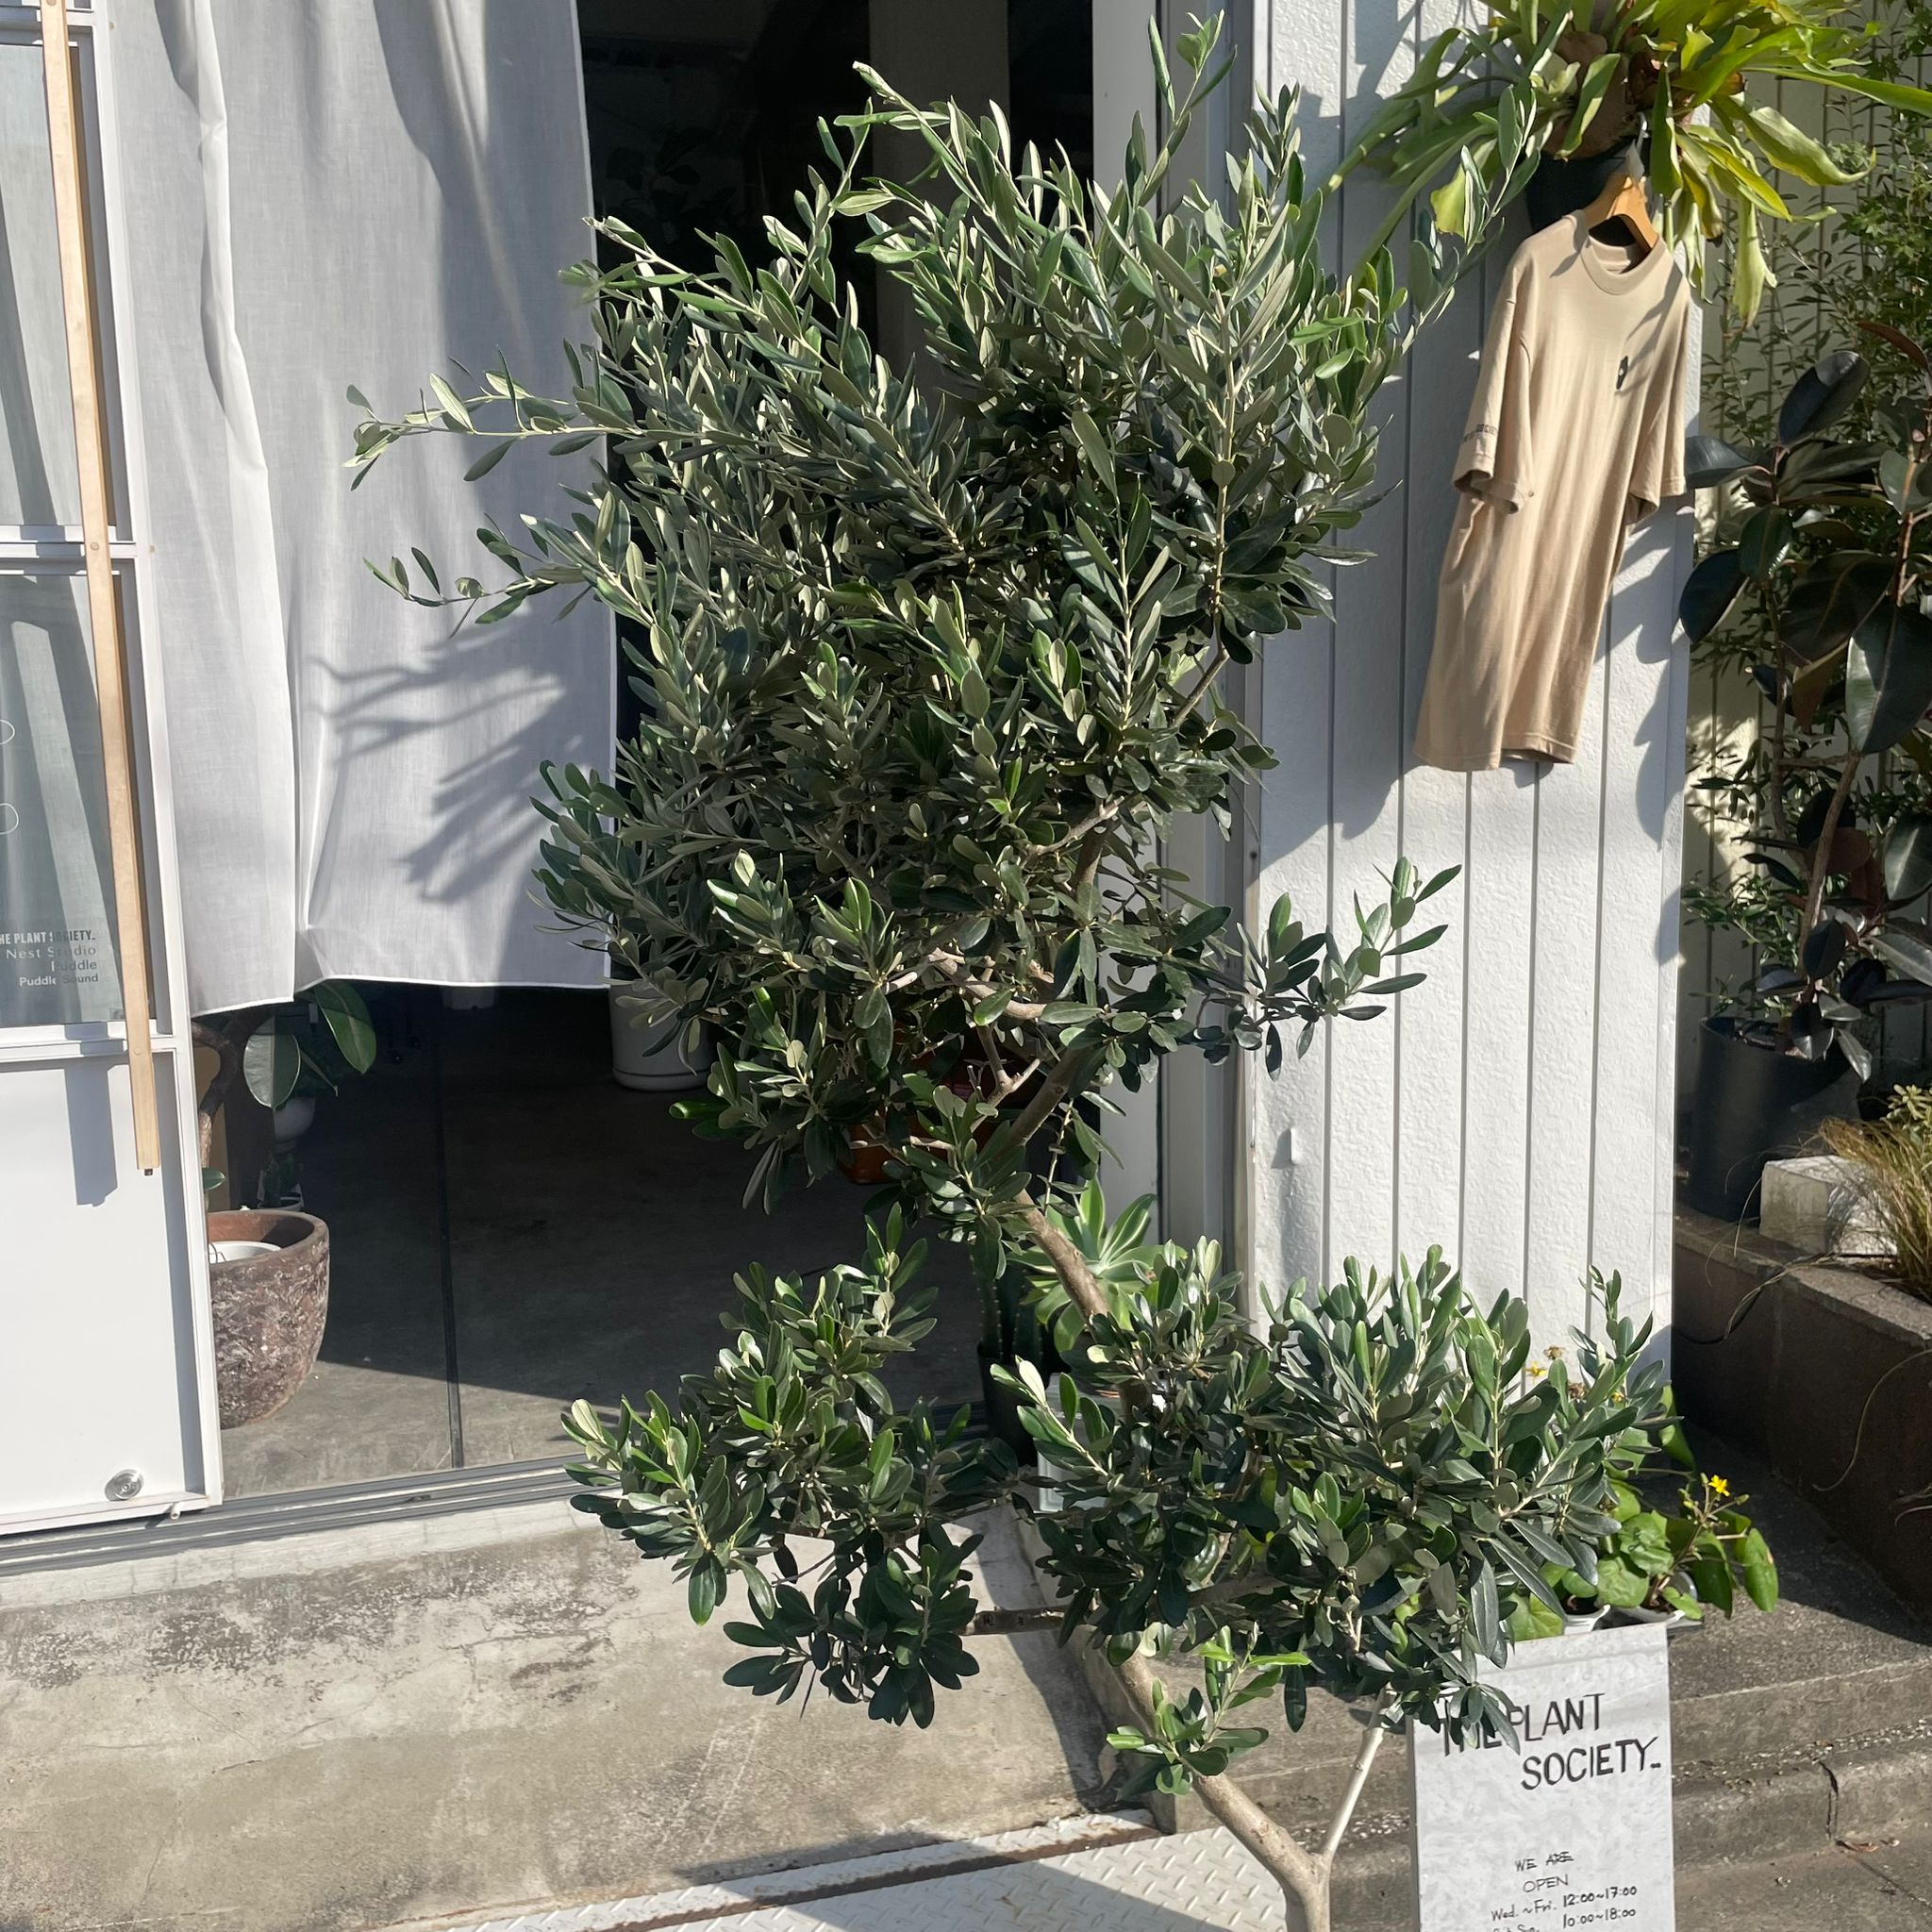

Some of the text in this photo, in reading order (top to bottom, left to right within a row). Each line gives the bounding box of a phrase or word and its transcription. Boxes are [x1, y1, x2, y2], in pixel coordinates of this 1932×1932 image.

[0, 933, 11, 944] HE
[13, 931, 46, 944] PLANT
[6, 944, 96, 959] Nest Studio
[51, 960, 97, 972] Puddle
[19, 974, 98, 987] Puddle Sound
[1514, 1851, 1574, 1872] WE ARE
[1522, 1874, 1569, 1892] OPEN
